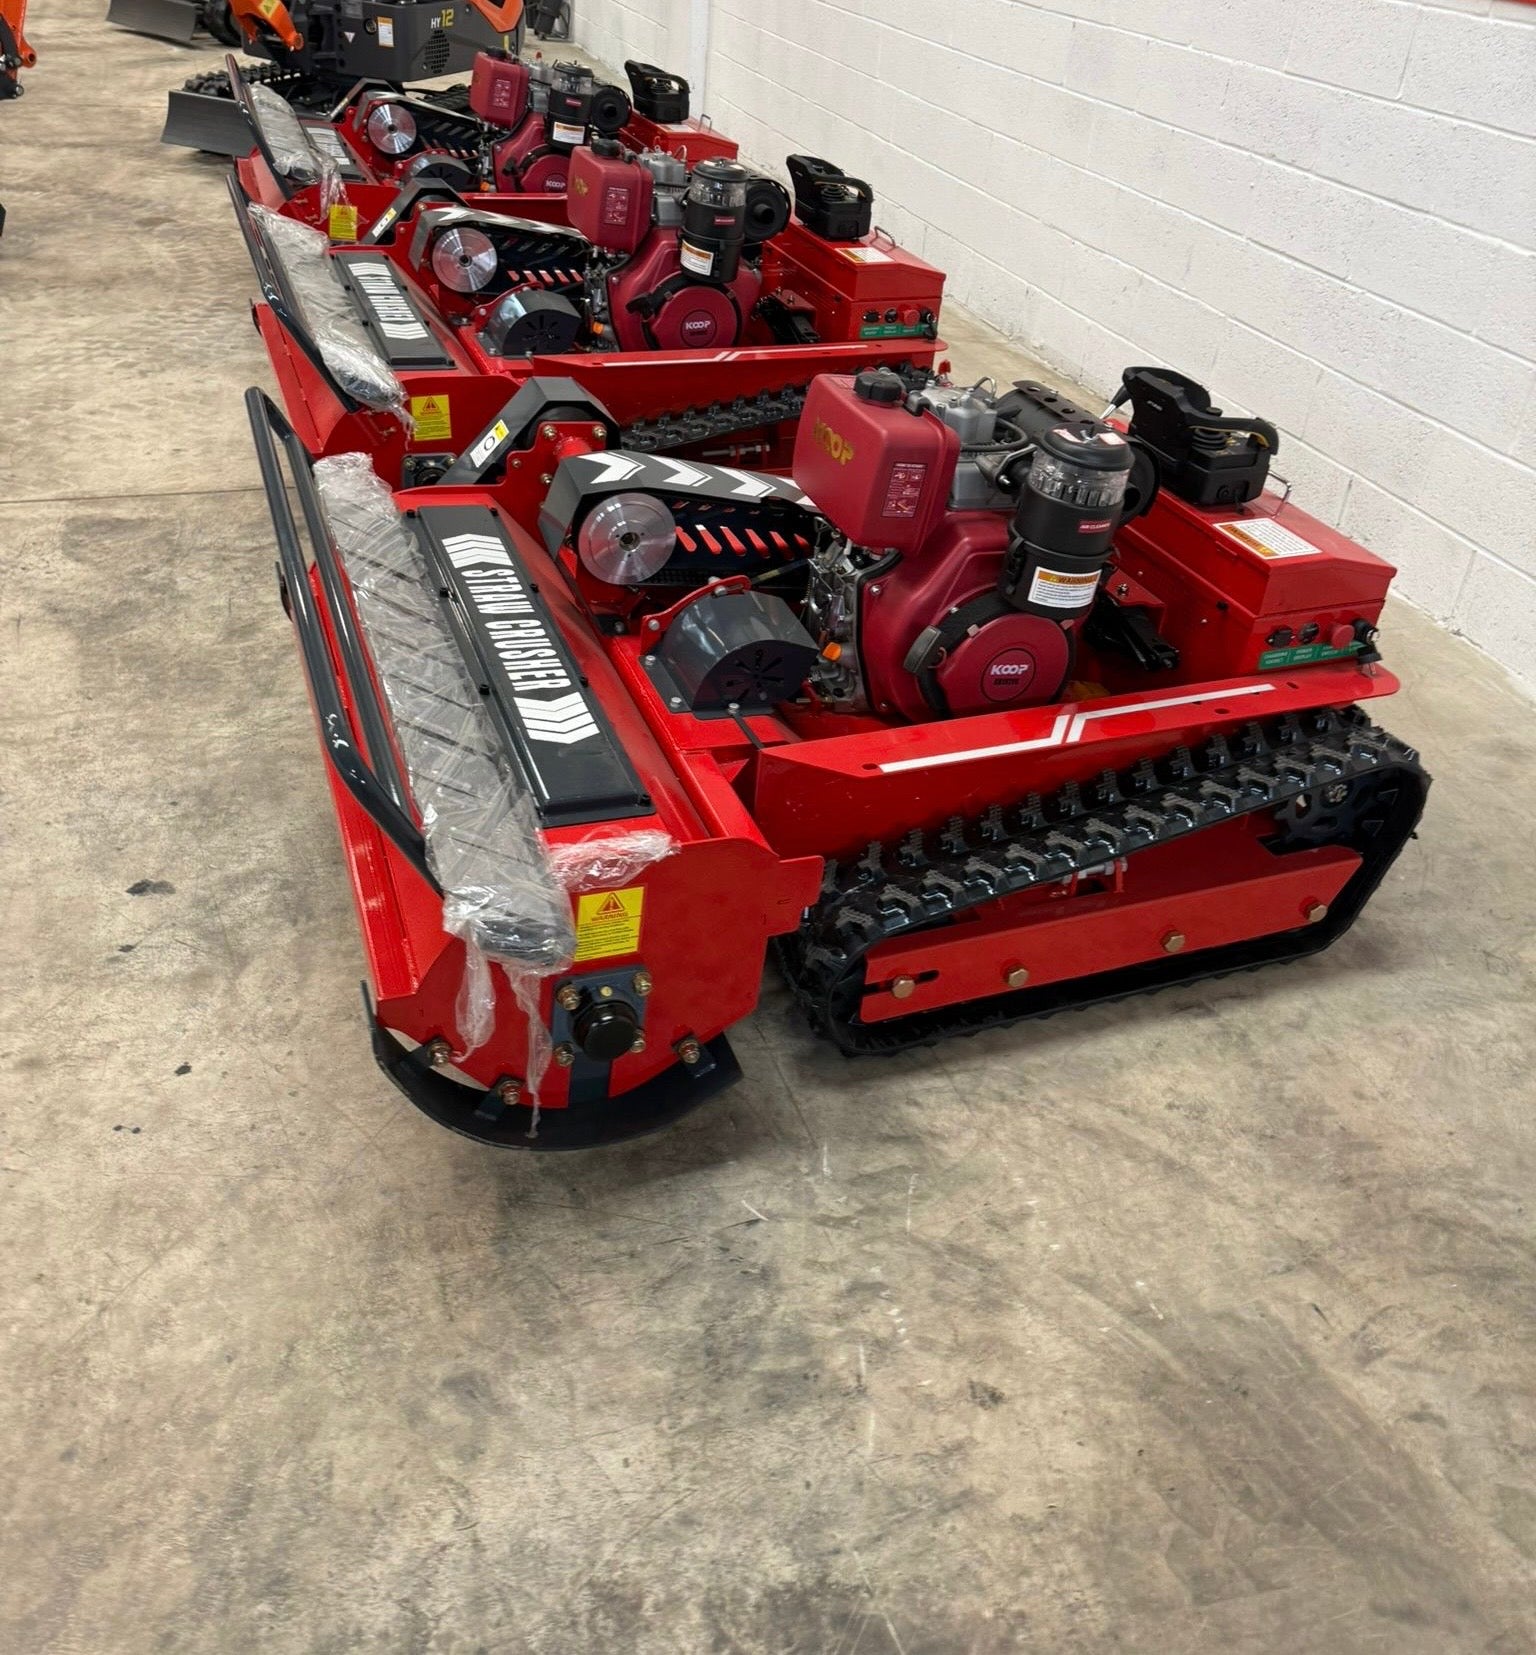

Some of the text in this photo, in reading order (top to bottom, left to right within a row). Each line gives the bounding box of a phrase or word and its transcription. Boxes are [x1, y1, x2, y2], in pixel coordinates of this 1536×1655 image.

[431, 8, 455, 29] HY 12
[685, 320, 711, 330] KOOP
[460, 568, 572, 692] STRAW CRUSHER
[990, 664, 1030, 676] KOOP
